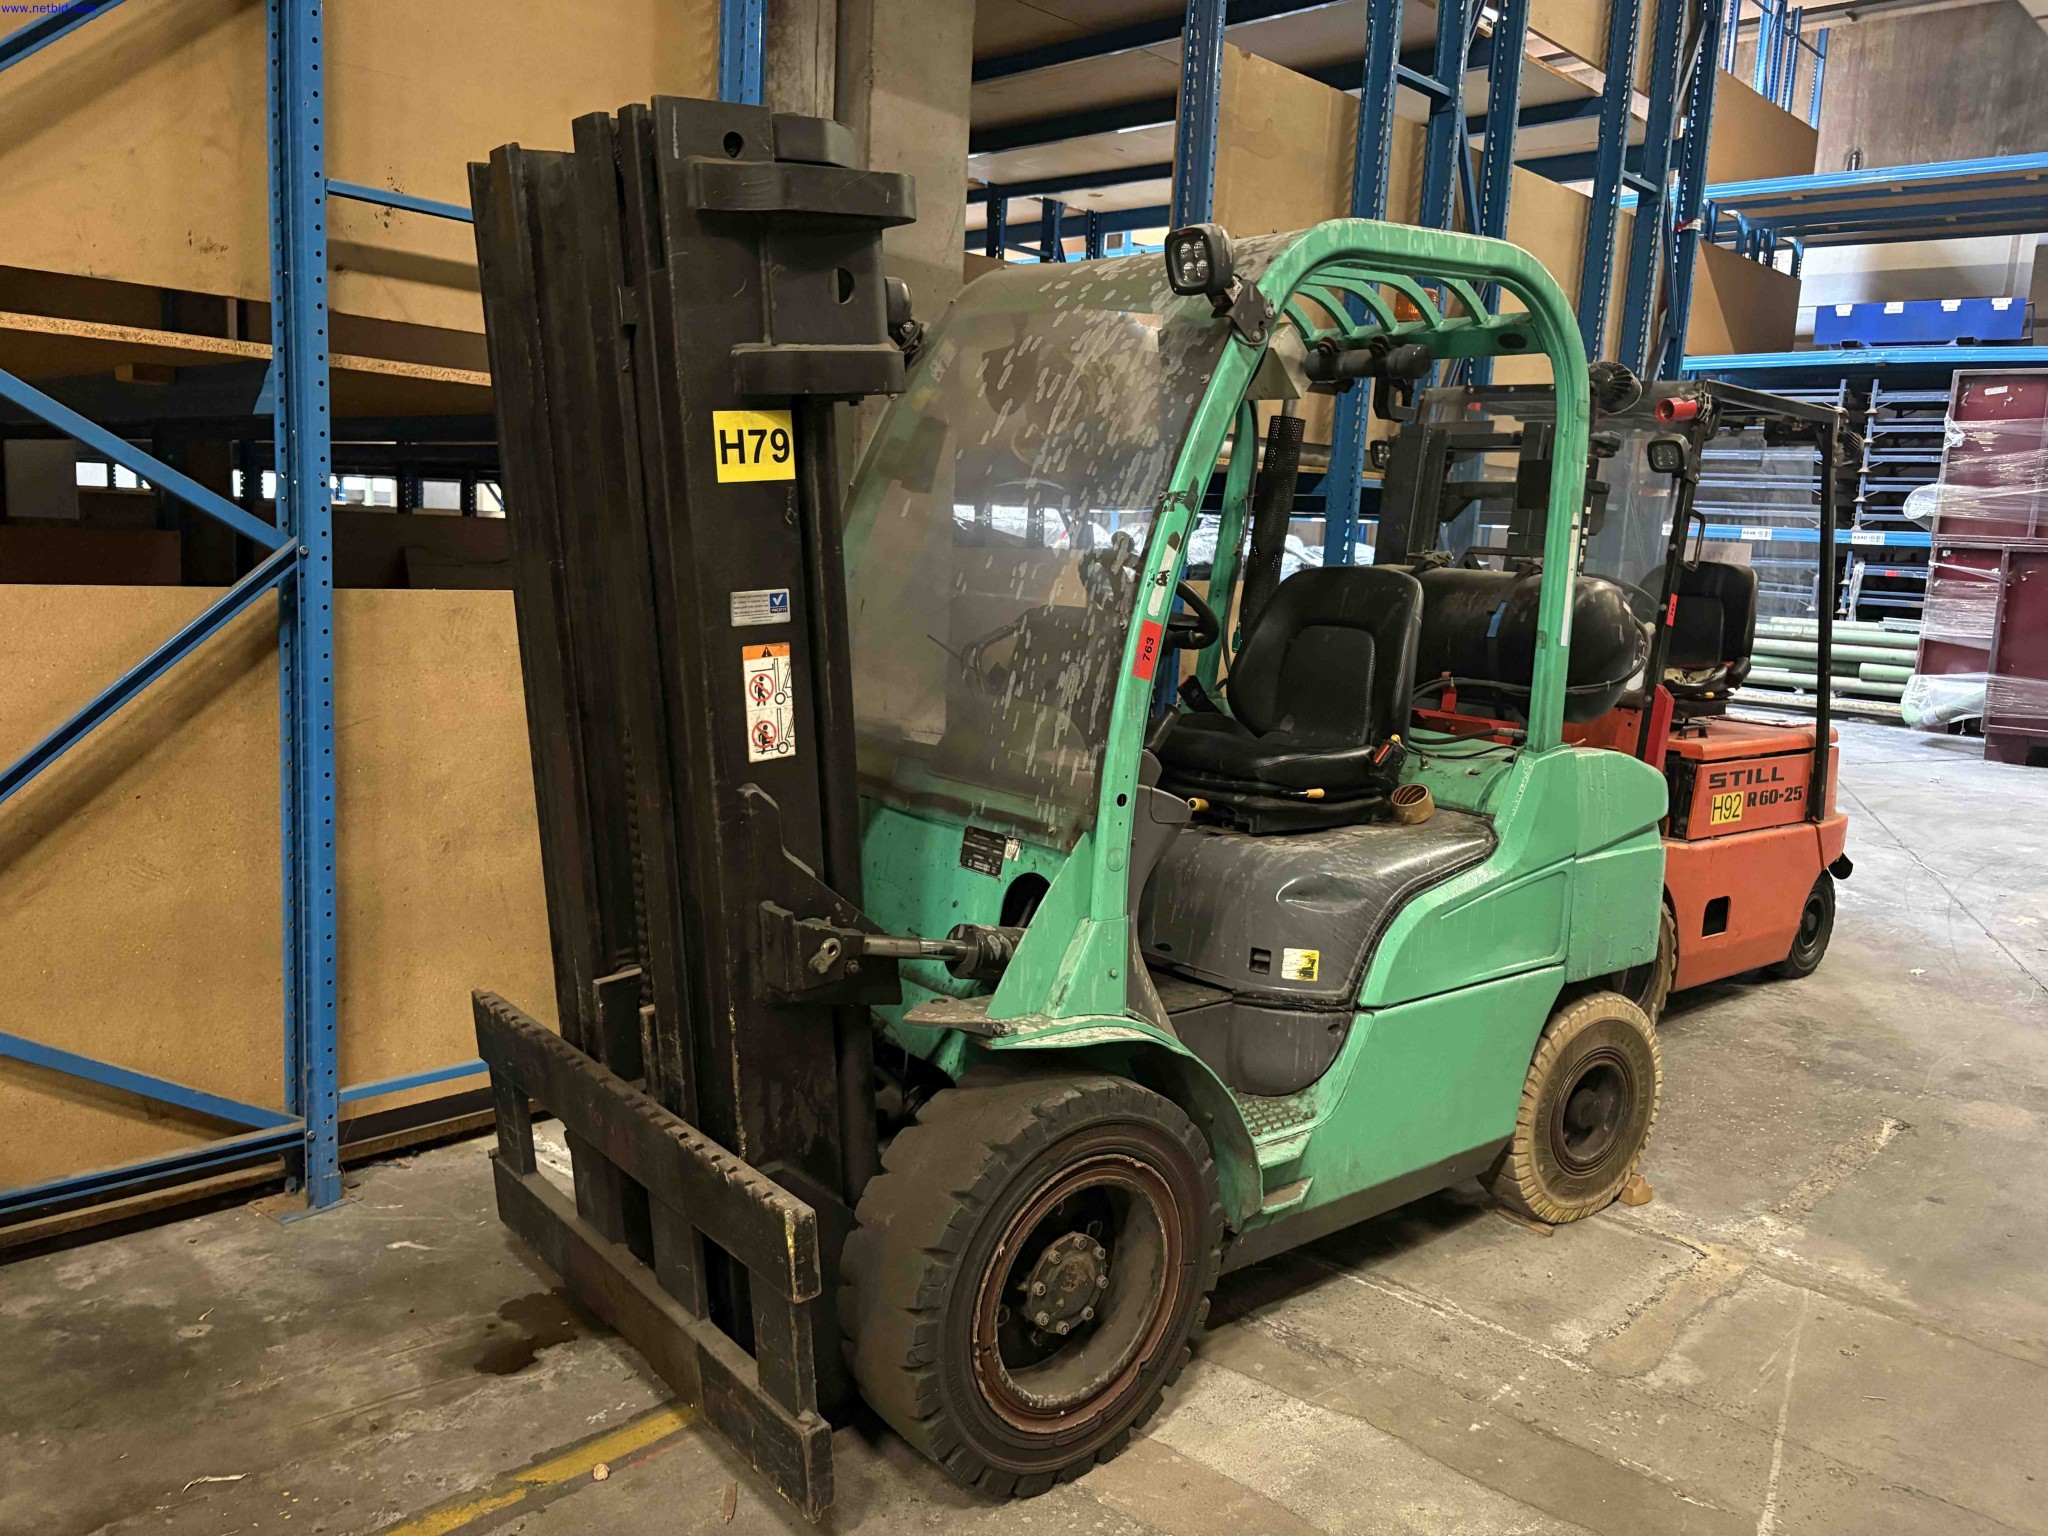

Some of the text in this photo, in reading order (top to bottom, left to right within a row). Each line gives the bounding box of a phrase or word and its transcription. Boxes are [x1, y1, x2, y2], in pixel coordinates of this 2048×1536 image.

[719, 428, 790, 465] H79
[1143, 637, 1154, 661] 763
[1708, 766, 1785, 789] STILL
[1711, 793, 1742, 822] H92
[1746, 785, 1803, 807] R 60-25
